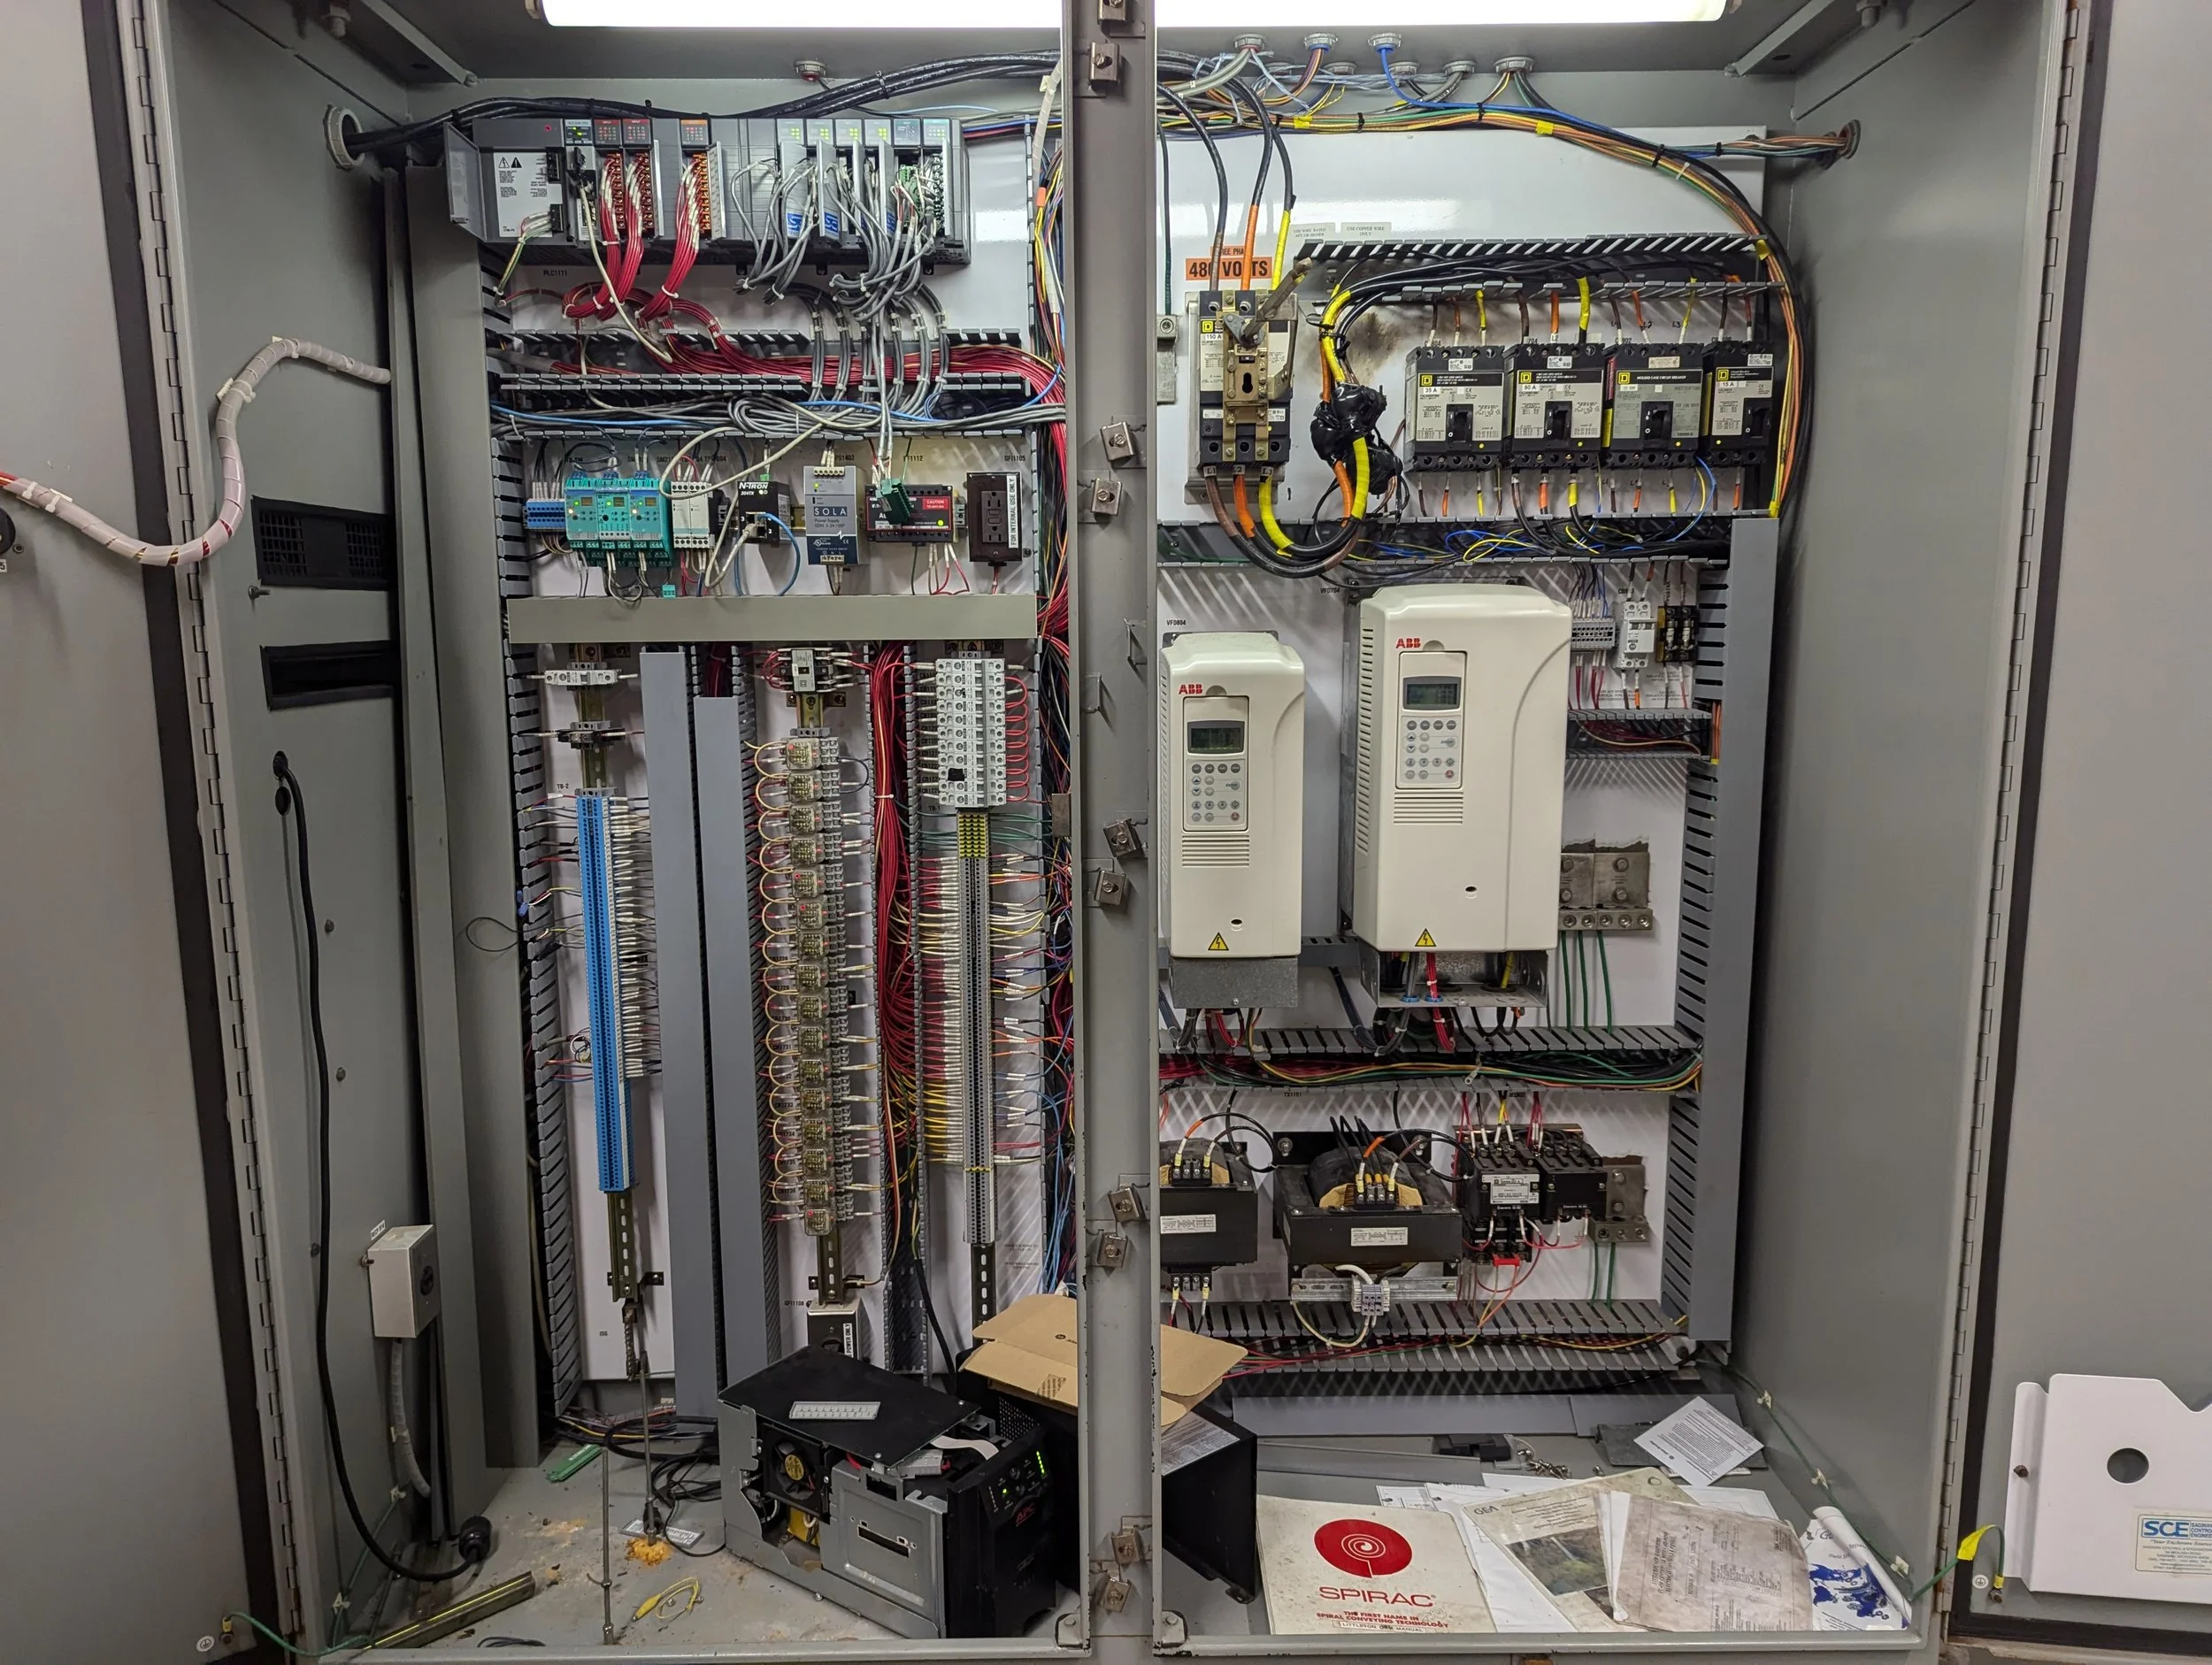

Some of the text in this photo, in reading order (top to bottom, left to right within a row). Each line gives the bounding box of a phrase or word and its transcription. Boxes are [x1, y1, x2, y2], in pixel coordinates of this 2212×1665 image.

[1222, 260, 1268, 276] VOTS
[815, 507, 847, 516] SOLA
[1395, 638, 1421, 648] ABB
[1179, 684, 1202, 694] ABB
[1473, 1505, 1499, 1515] GEA
[2144, 1521, 2189, 1537] SCE
[1318, 1586, 1433, 1607] SPIRAC
[1346, 1615, 1394, 1624] CONVEYING
